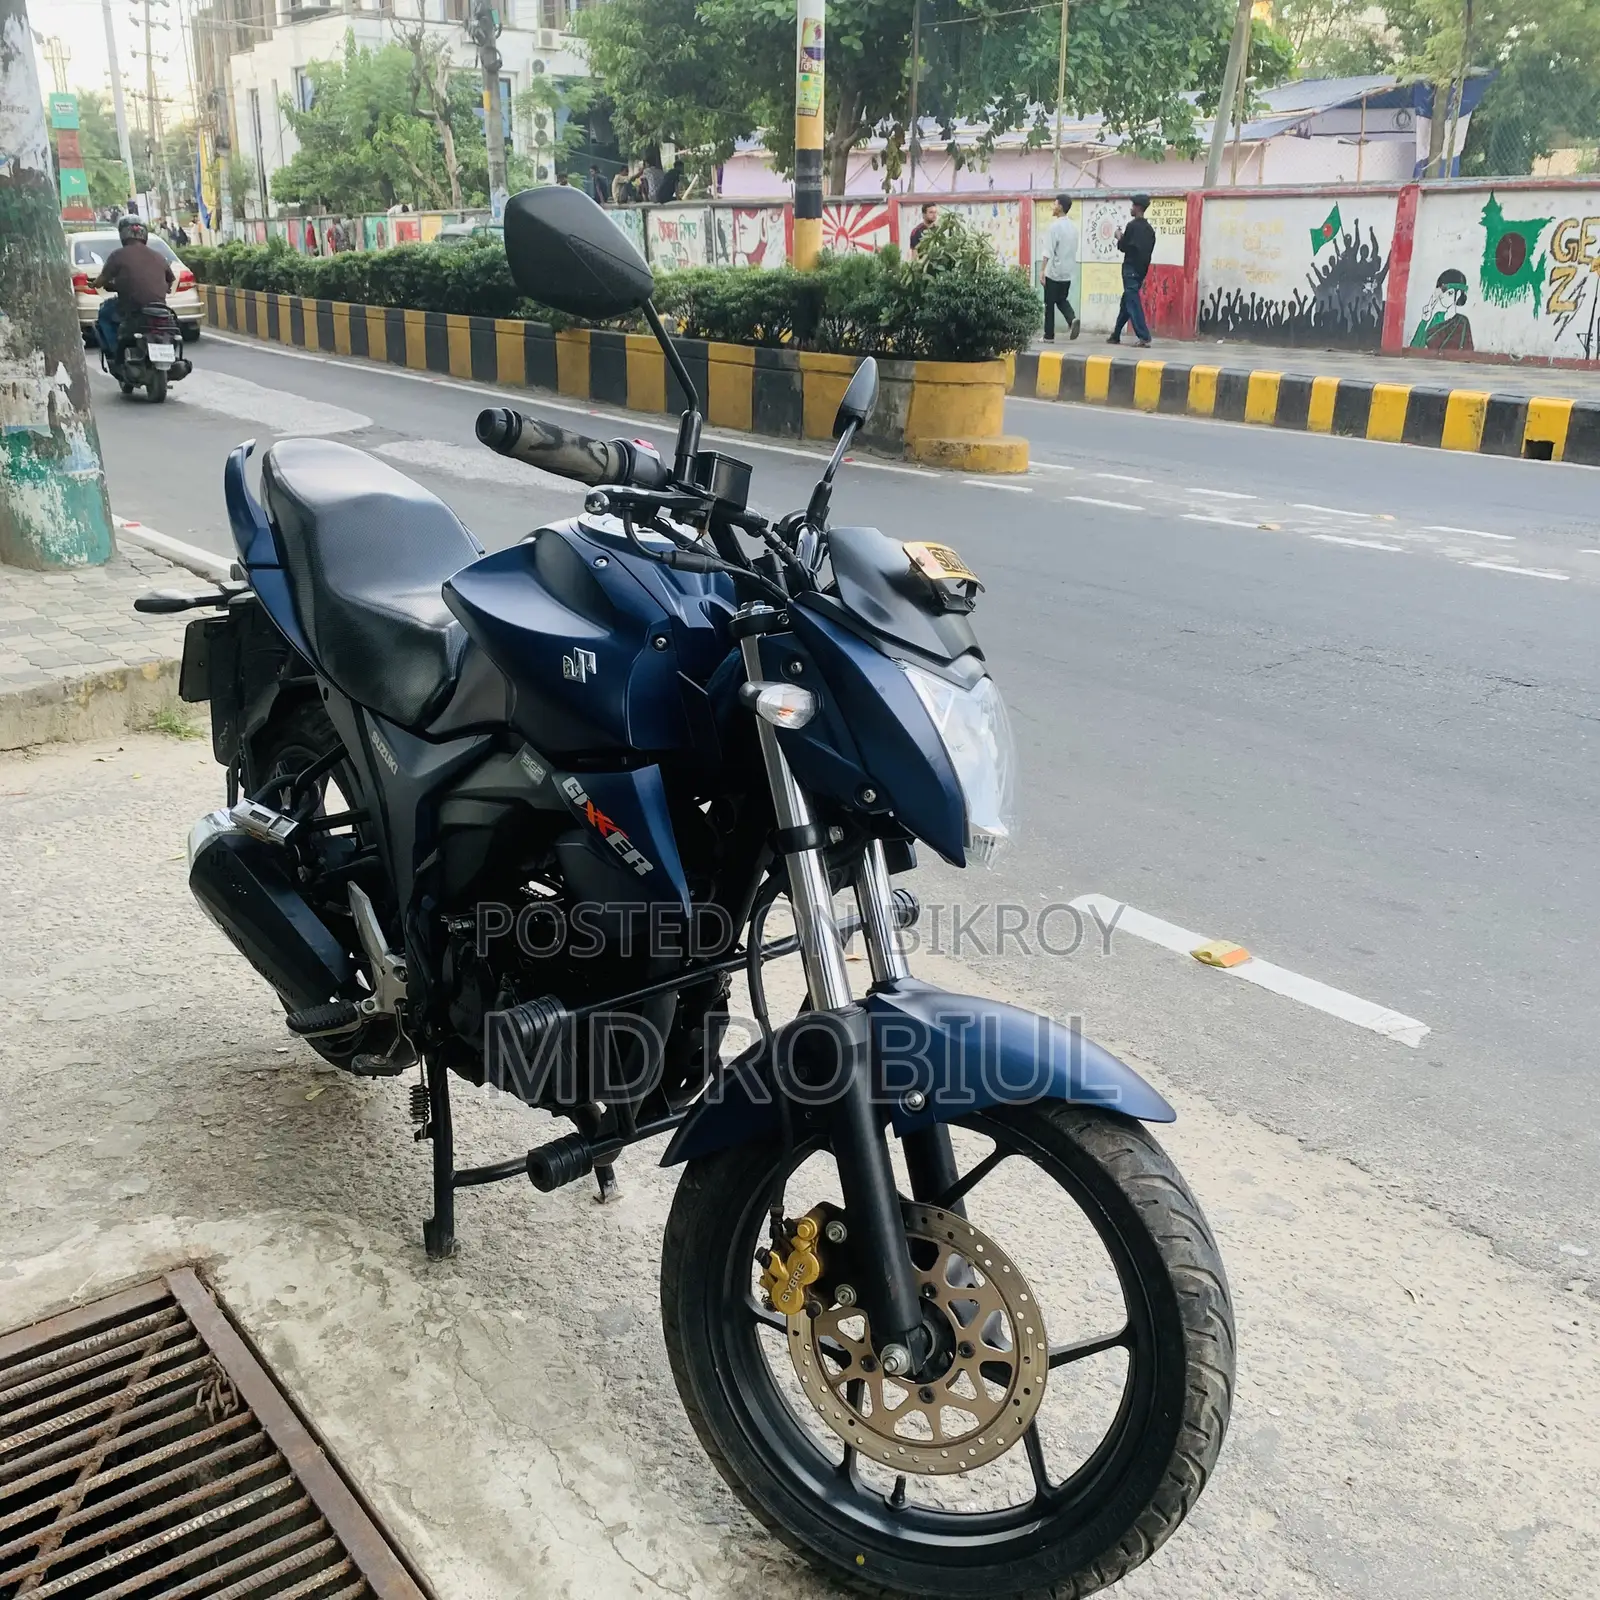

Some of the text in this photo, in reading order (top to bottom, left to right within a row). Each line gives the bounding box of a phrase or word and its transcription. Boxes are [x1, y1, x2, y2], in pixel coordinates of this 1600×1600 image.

[1168, 226, 1186, 235] LEAVE
[371, 731, 398, 776] SUZUKI
[522, 754, 544, 775] SEP
[781, 1263, 806, 1303] BYBRE
